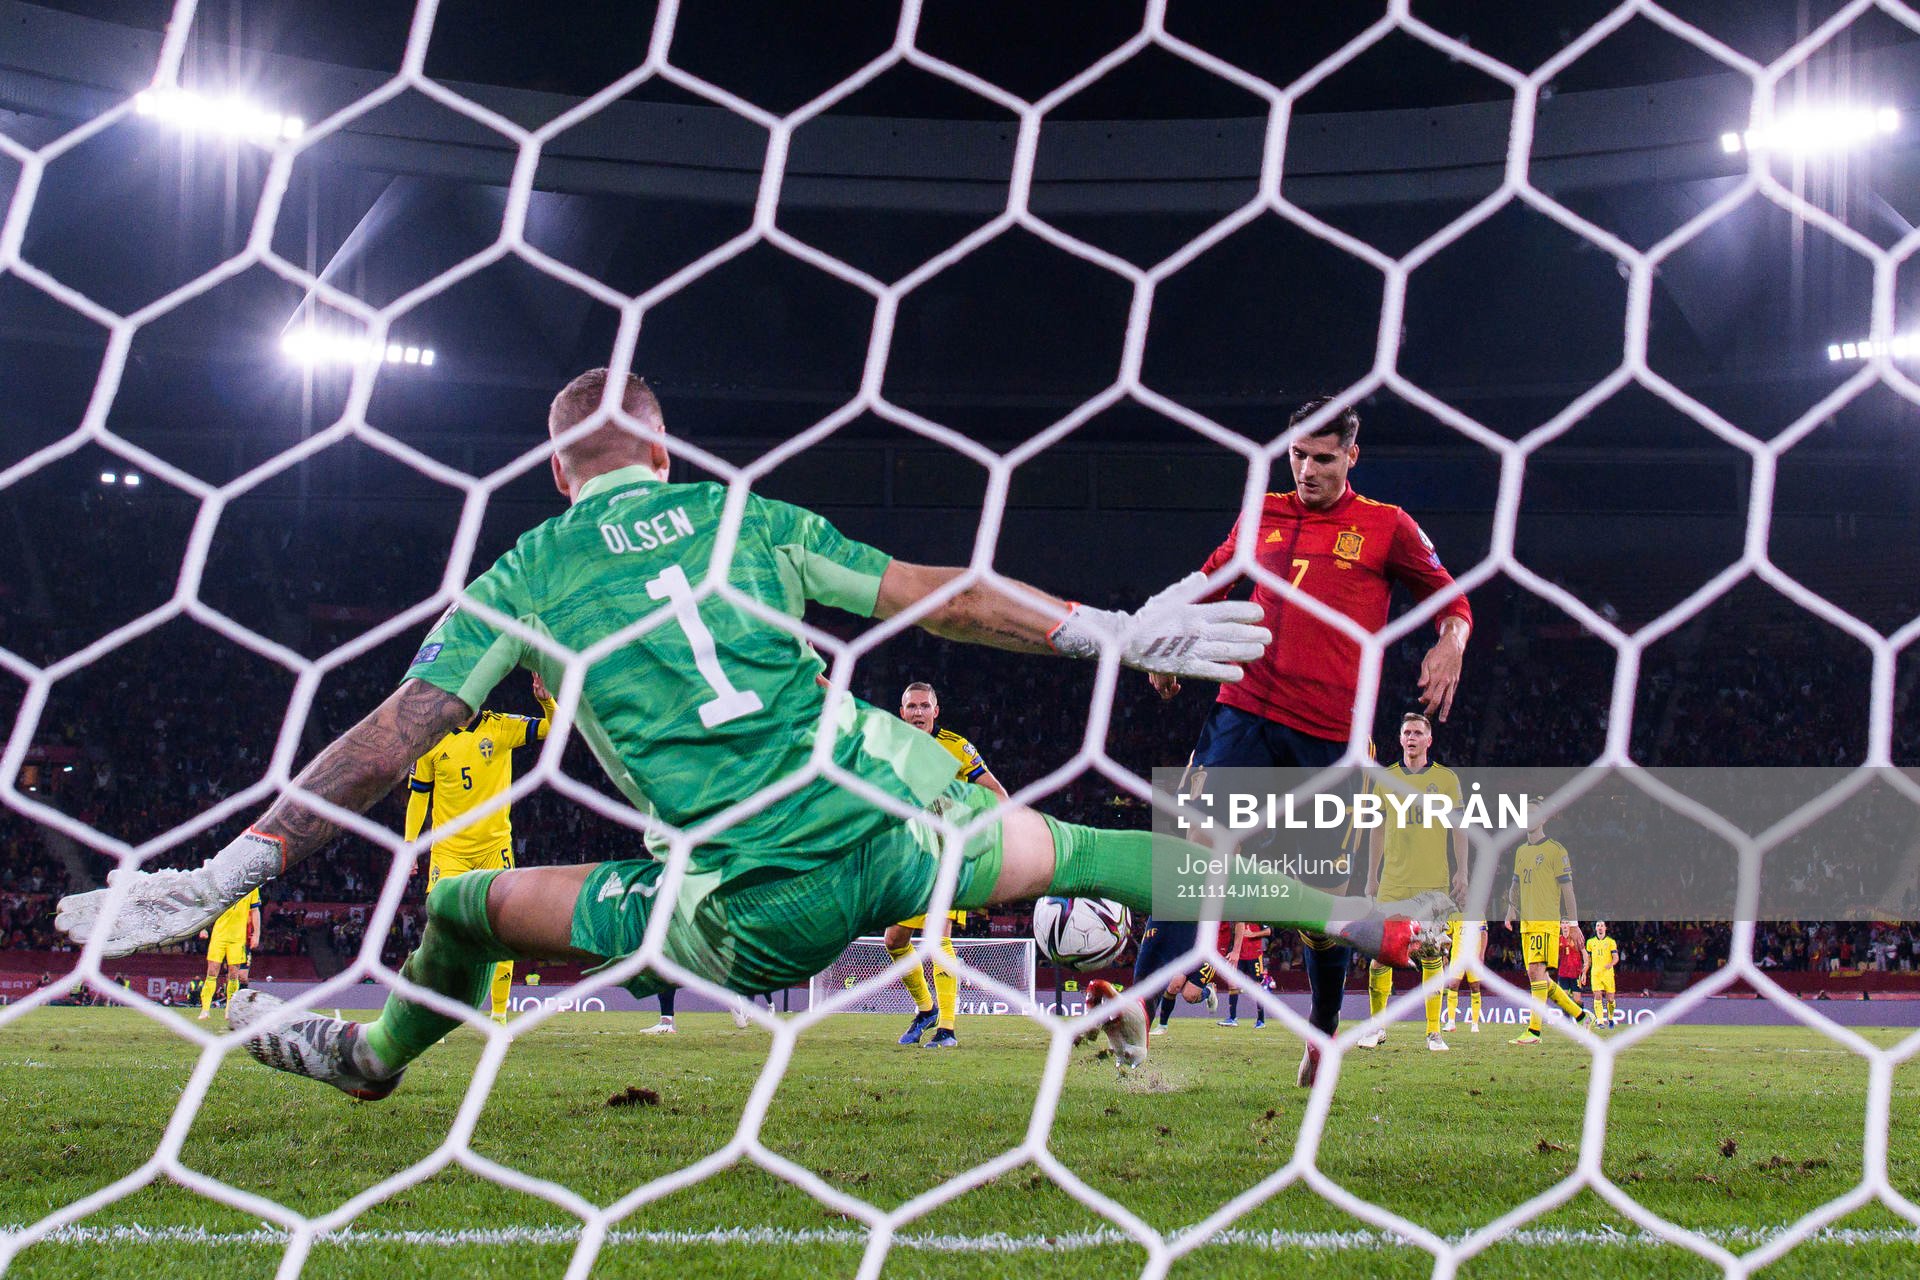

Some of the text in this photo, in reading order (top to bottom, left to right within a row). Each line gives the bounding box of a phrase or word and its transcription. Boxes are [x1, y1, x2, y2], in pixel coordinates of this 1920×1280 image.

[600, 506, 695, 554] OLSEN
[1292, 559, 1310, 589] 7
[645, 564, 764, 728] 1
[461, 767, 473, 790] 5
[501, 848, 510, 869] 5
[1530, 934, 1542, 950] 20
[0, 980, 32, 989] EAT
